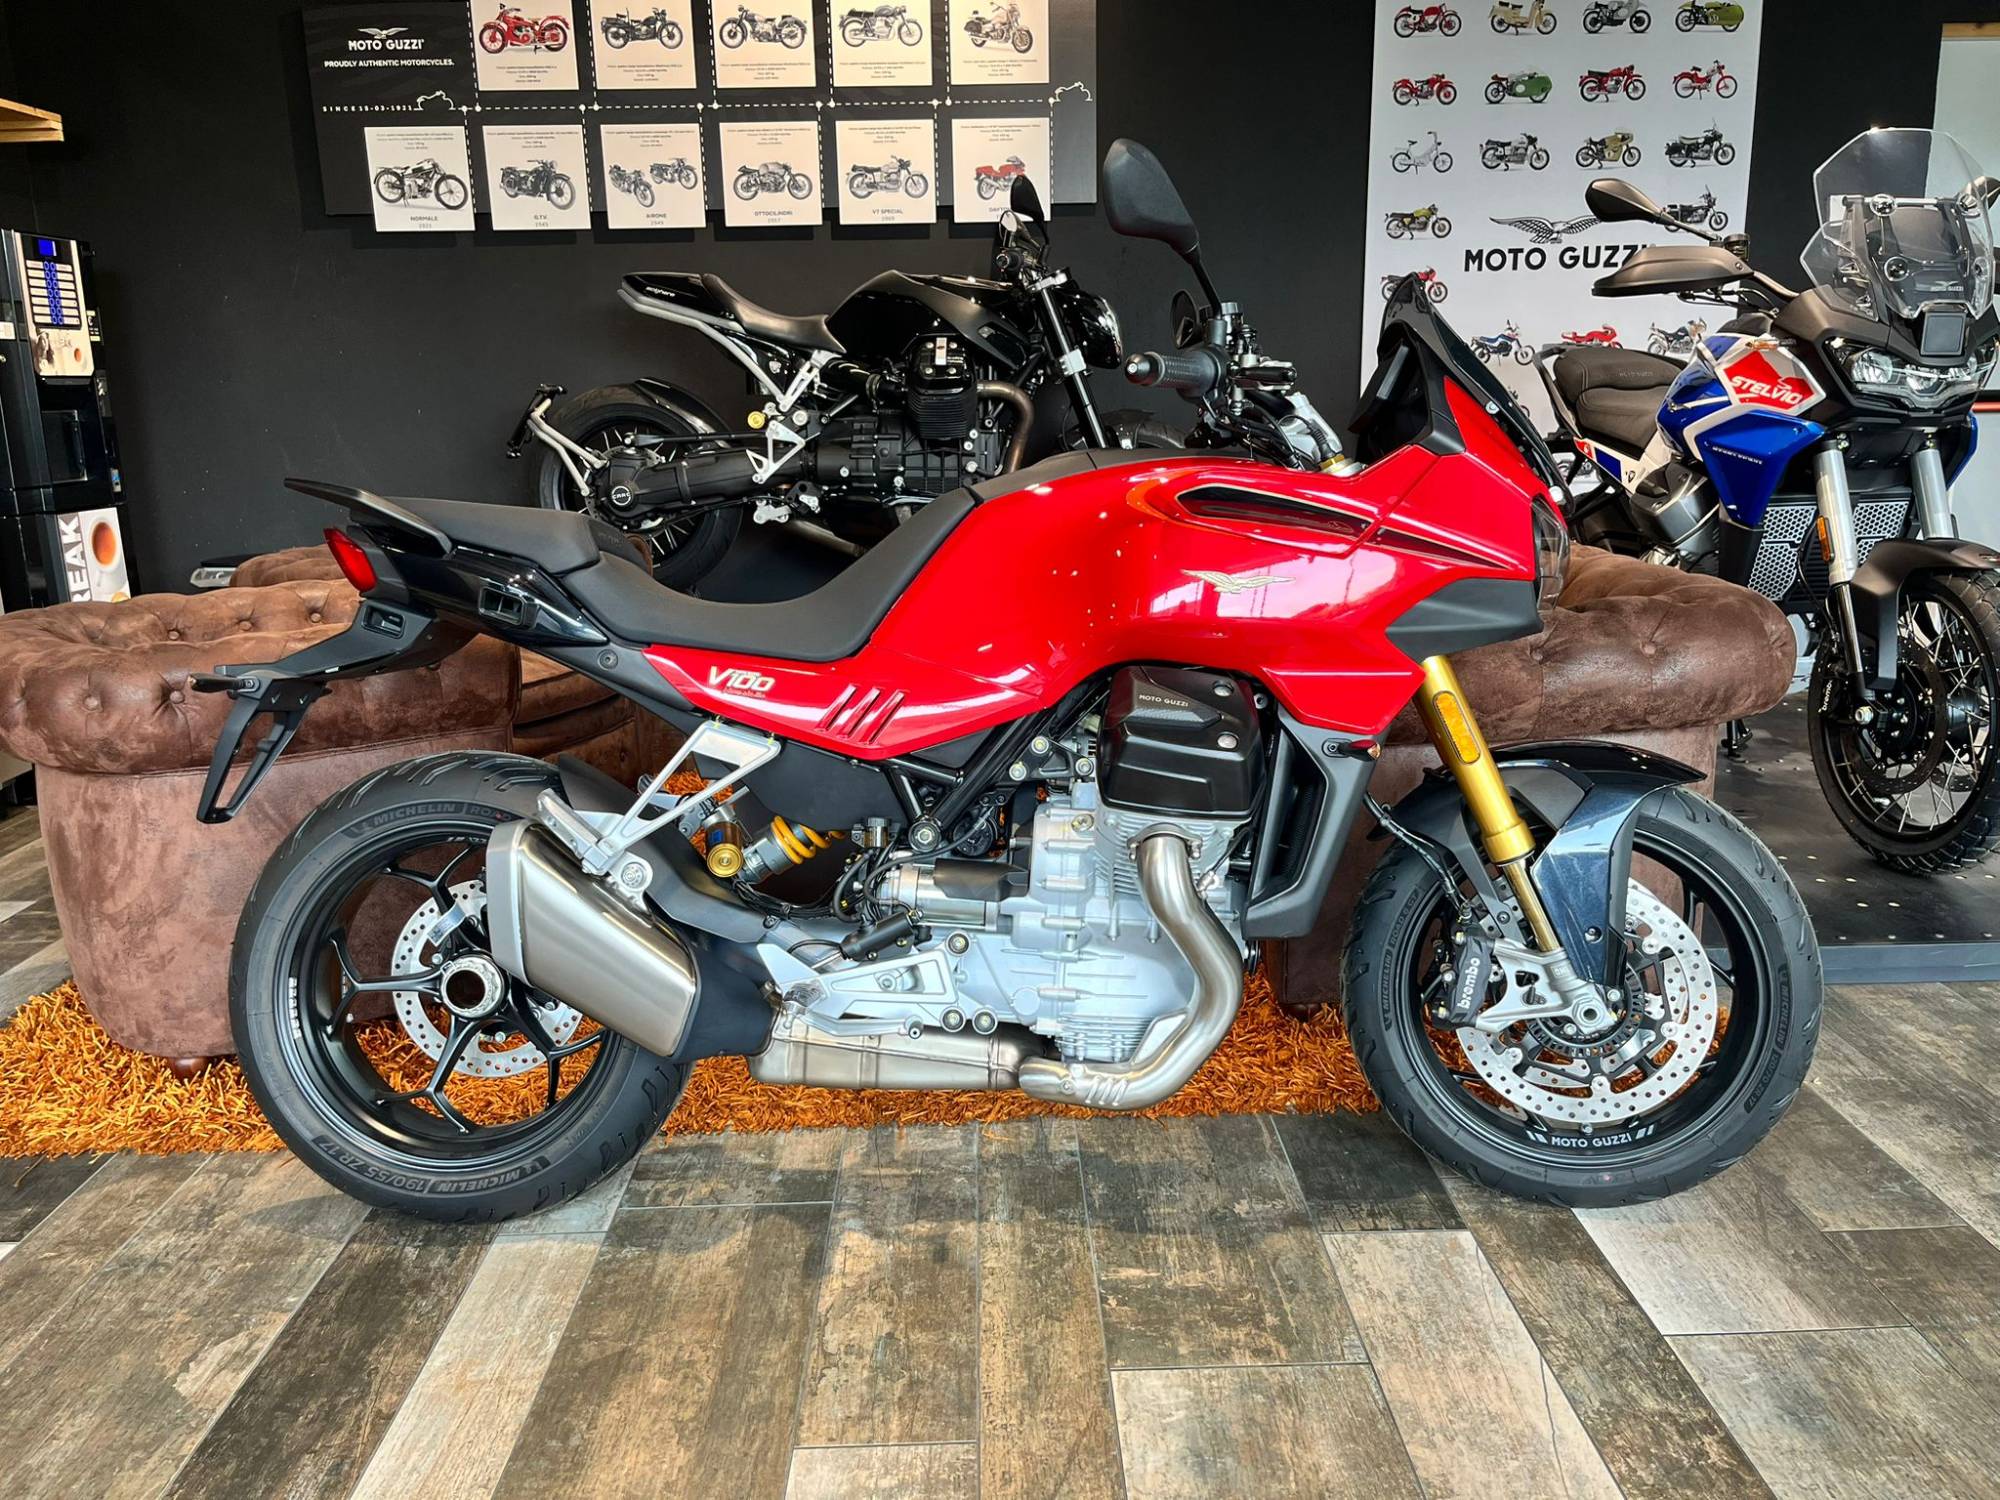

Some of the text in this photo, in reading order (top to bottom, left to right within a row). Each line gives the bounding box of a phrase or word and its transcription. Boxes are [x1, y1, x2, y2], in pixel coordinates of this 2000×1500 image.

[348, 39, 423, 51] MOTO GUZZI
[324, 60, 357, 68] PROUDLY
[1464, 245, 1647, 272] MOTO GUZZ
[1731, 375, 1803, 405] STELVIO
[709, 665, 776, 692] V100
[1139, 694, 1189, 707] MOTO GUZZI
[1821, 680, 1832, 711] bremb
[373, 803, 455, 825] MICHELIN
[1382, 953, 1393, 1010] MICHELIN
[1457, 957, 1480, 1009] brembo
[1777, 984, 1790, 1044] MICHELIN
[1551, 1132, 1632, 1148] MOTO GUZZI
[319, 1139, 520, 1192] MICHELIN 190/55 ZR 17
